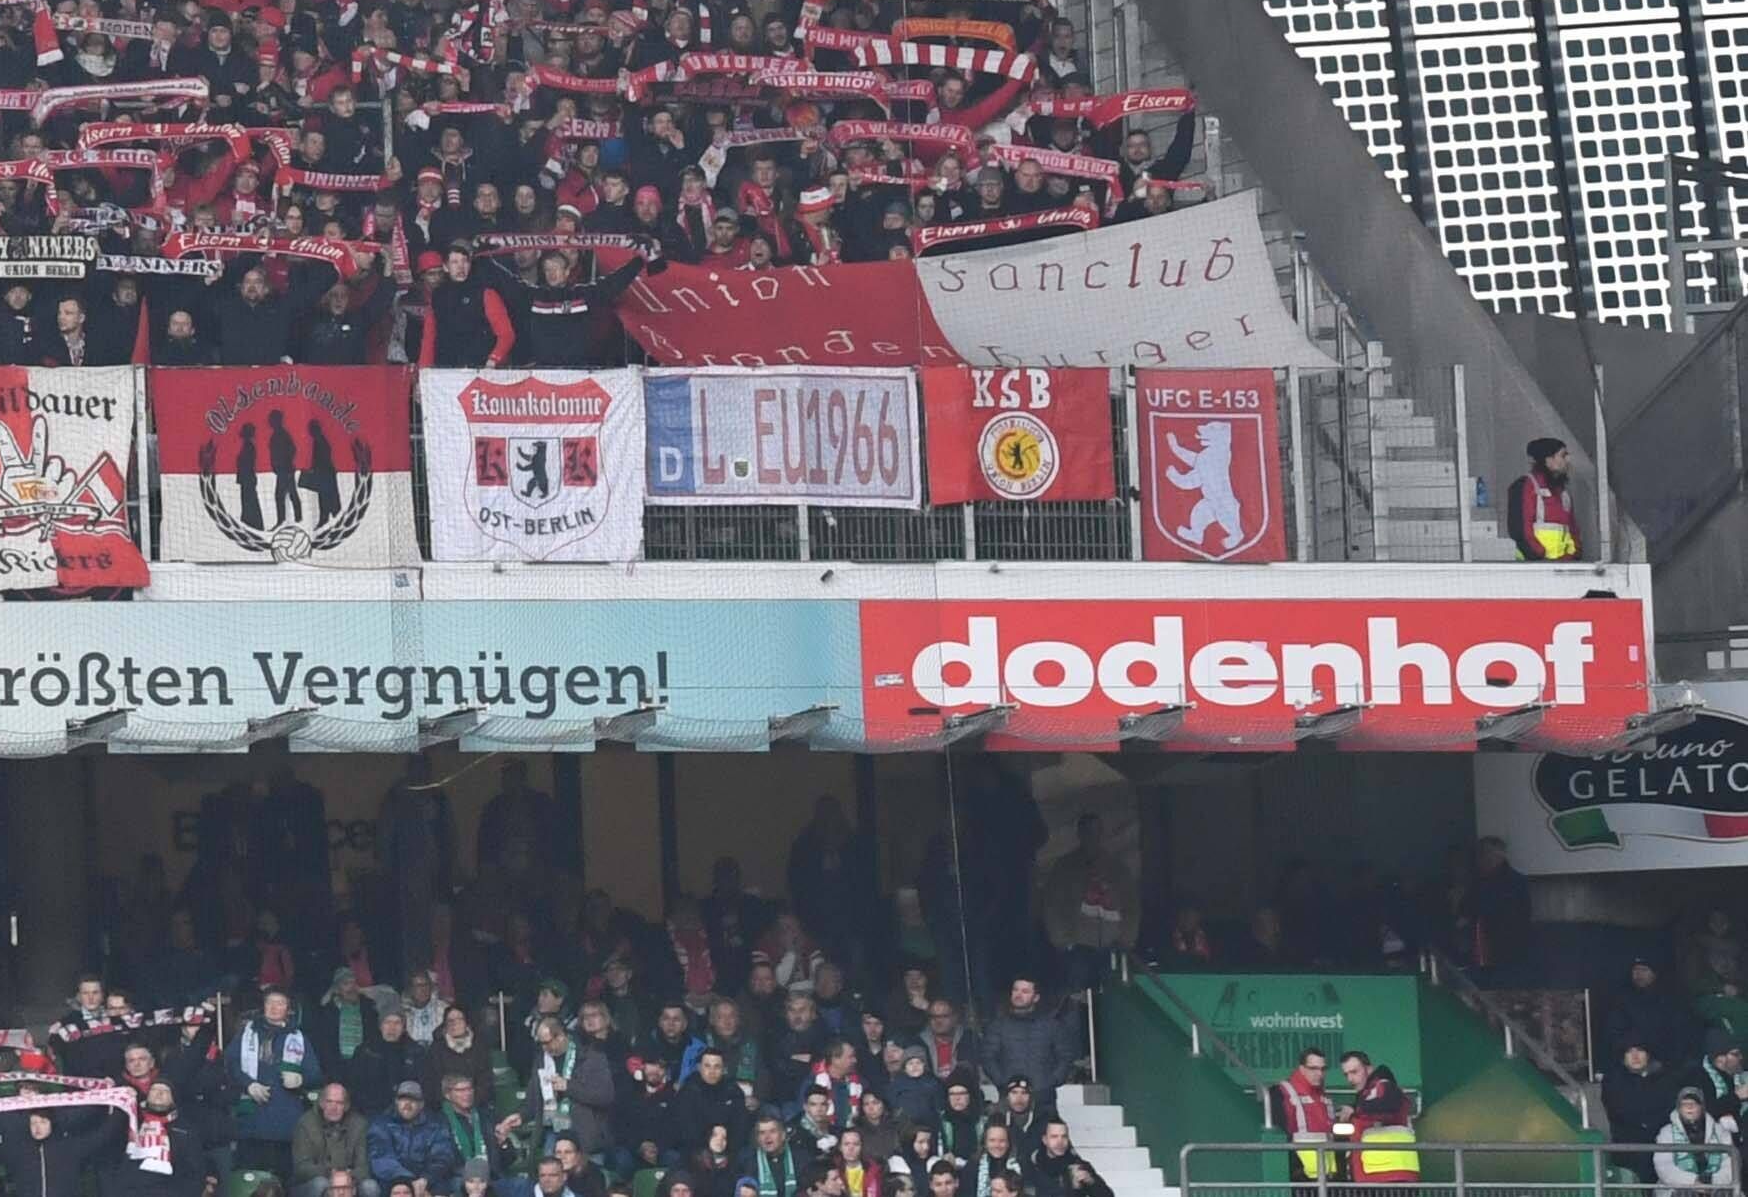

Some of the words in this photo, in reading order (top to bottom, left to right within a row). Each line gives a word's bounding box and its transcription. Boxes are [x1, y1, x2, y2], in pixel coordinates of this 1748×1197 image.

[824, 76, 875, 91] UNION
[1121, 93, 1187, 111] Eisern
[26, 234, 96, 261] NINERS
[177, 232, 243, 248] Eisern
[971, 368, 1052, 410] KSB
[1145, 388, 1193, 408] UFC
[1197, 388, 1261, 409] E-153
[478, 506, 597, 536] OST-BERLIN
[911, 615, 1595, 707] dodenhof
[253, 649, 669, 723] Vergnügen!
[1250, 1012, 1344, 1031] wohninvest
